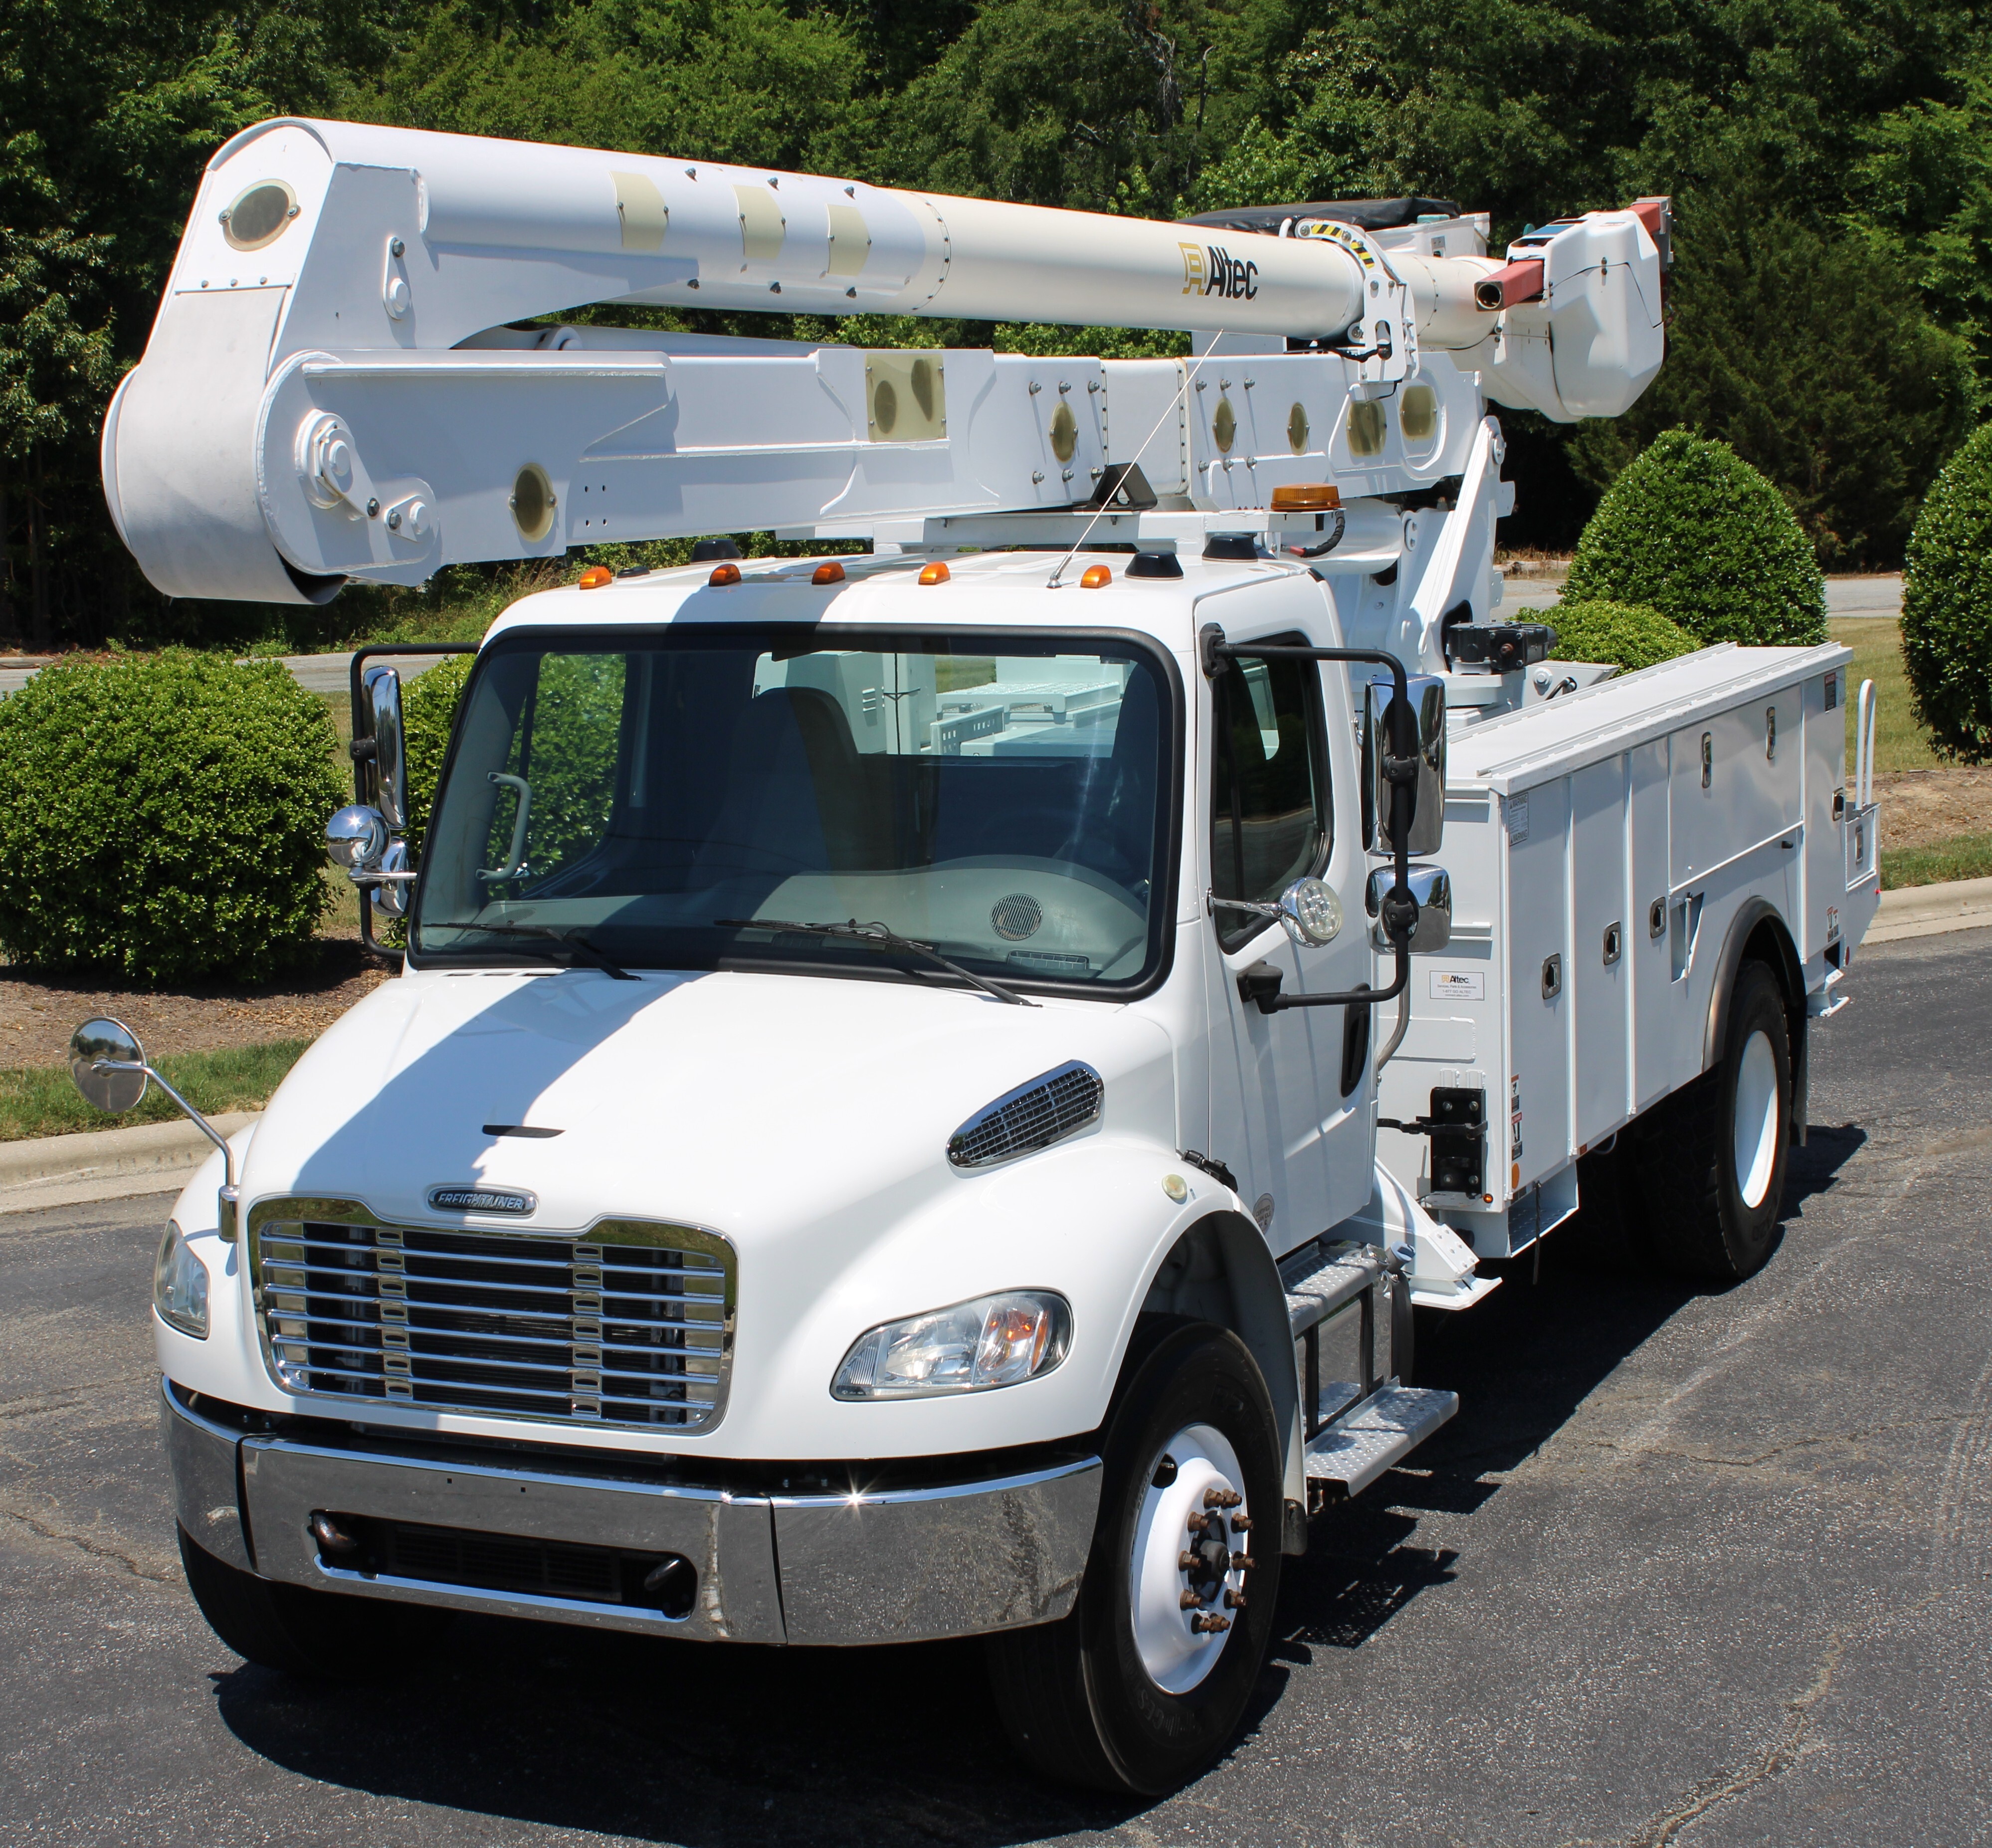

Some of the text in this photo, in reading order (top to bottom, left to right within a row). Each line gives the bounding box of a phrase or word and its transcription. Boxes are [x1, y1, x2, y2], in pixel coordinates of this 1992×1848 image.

[1205, 246, 1258, 300] Altec
[1450, 975, 1469, 983] Altec
[438, 1193, 523, 1209] FREIGHTLINER
